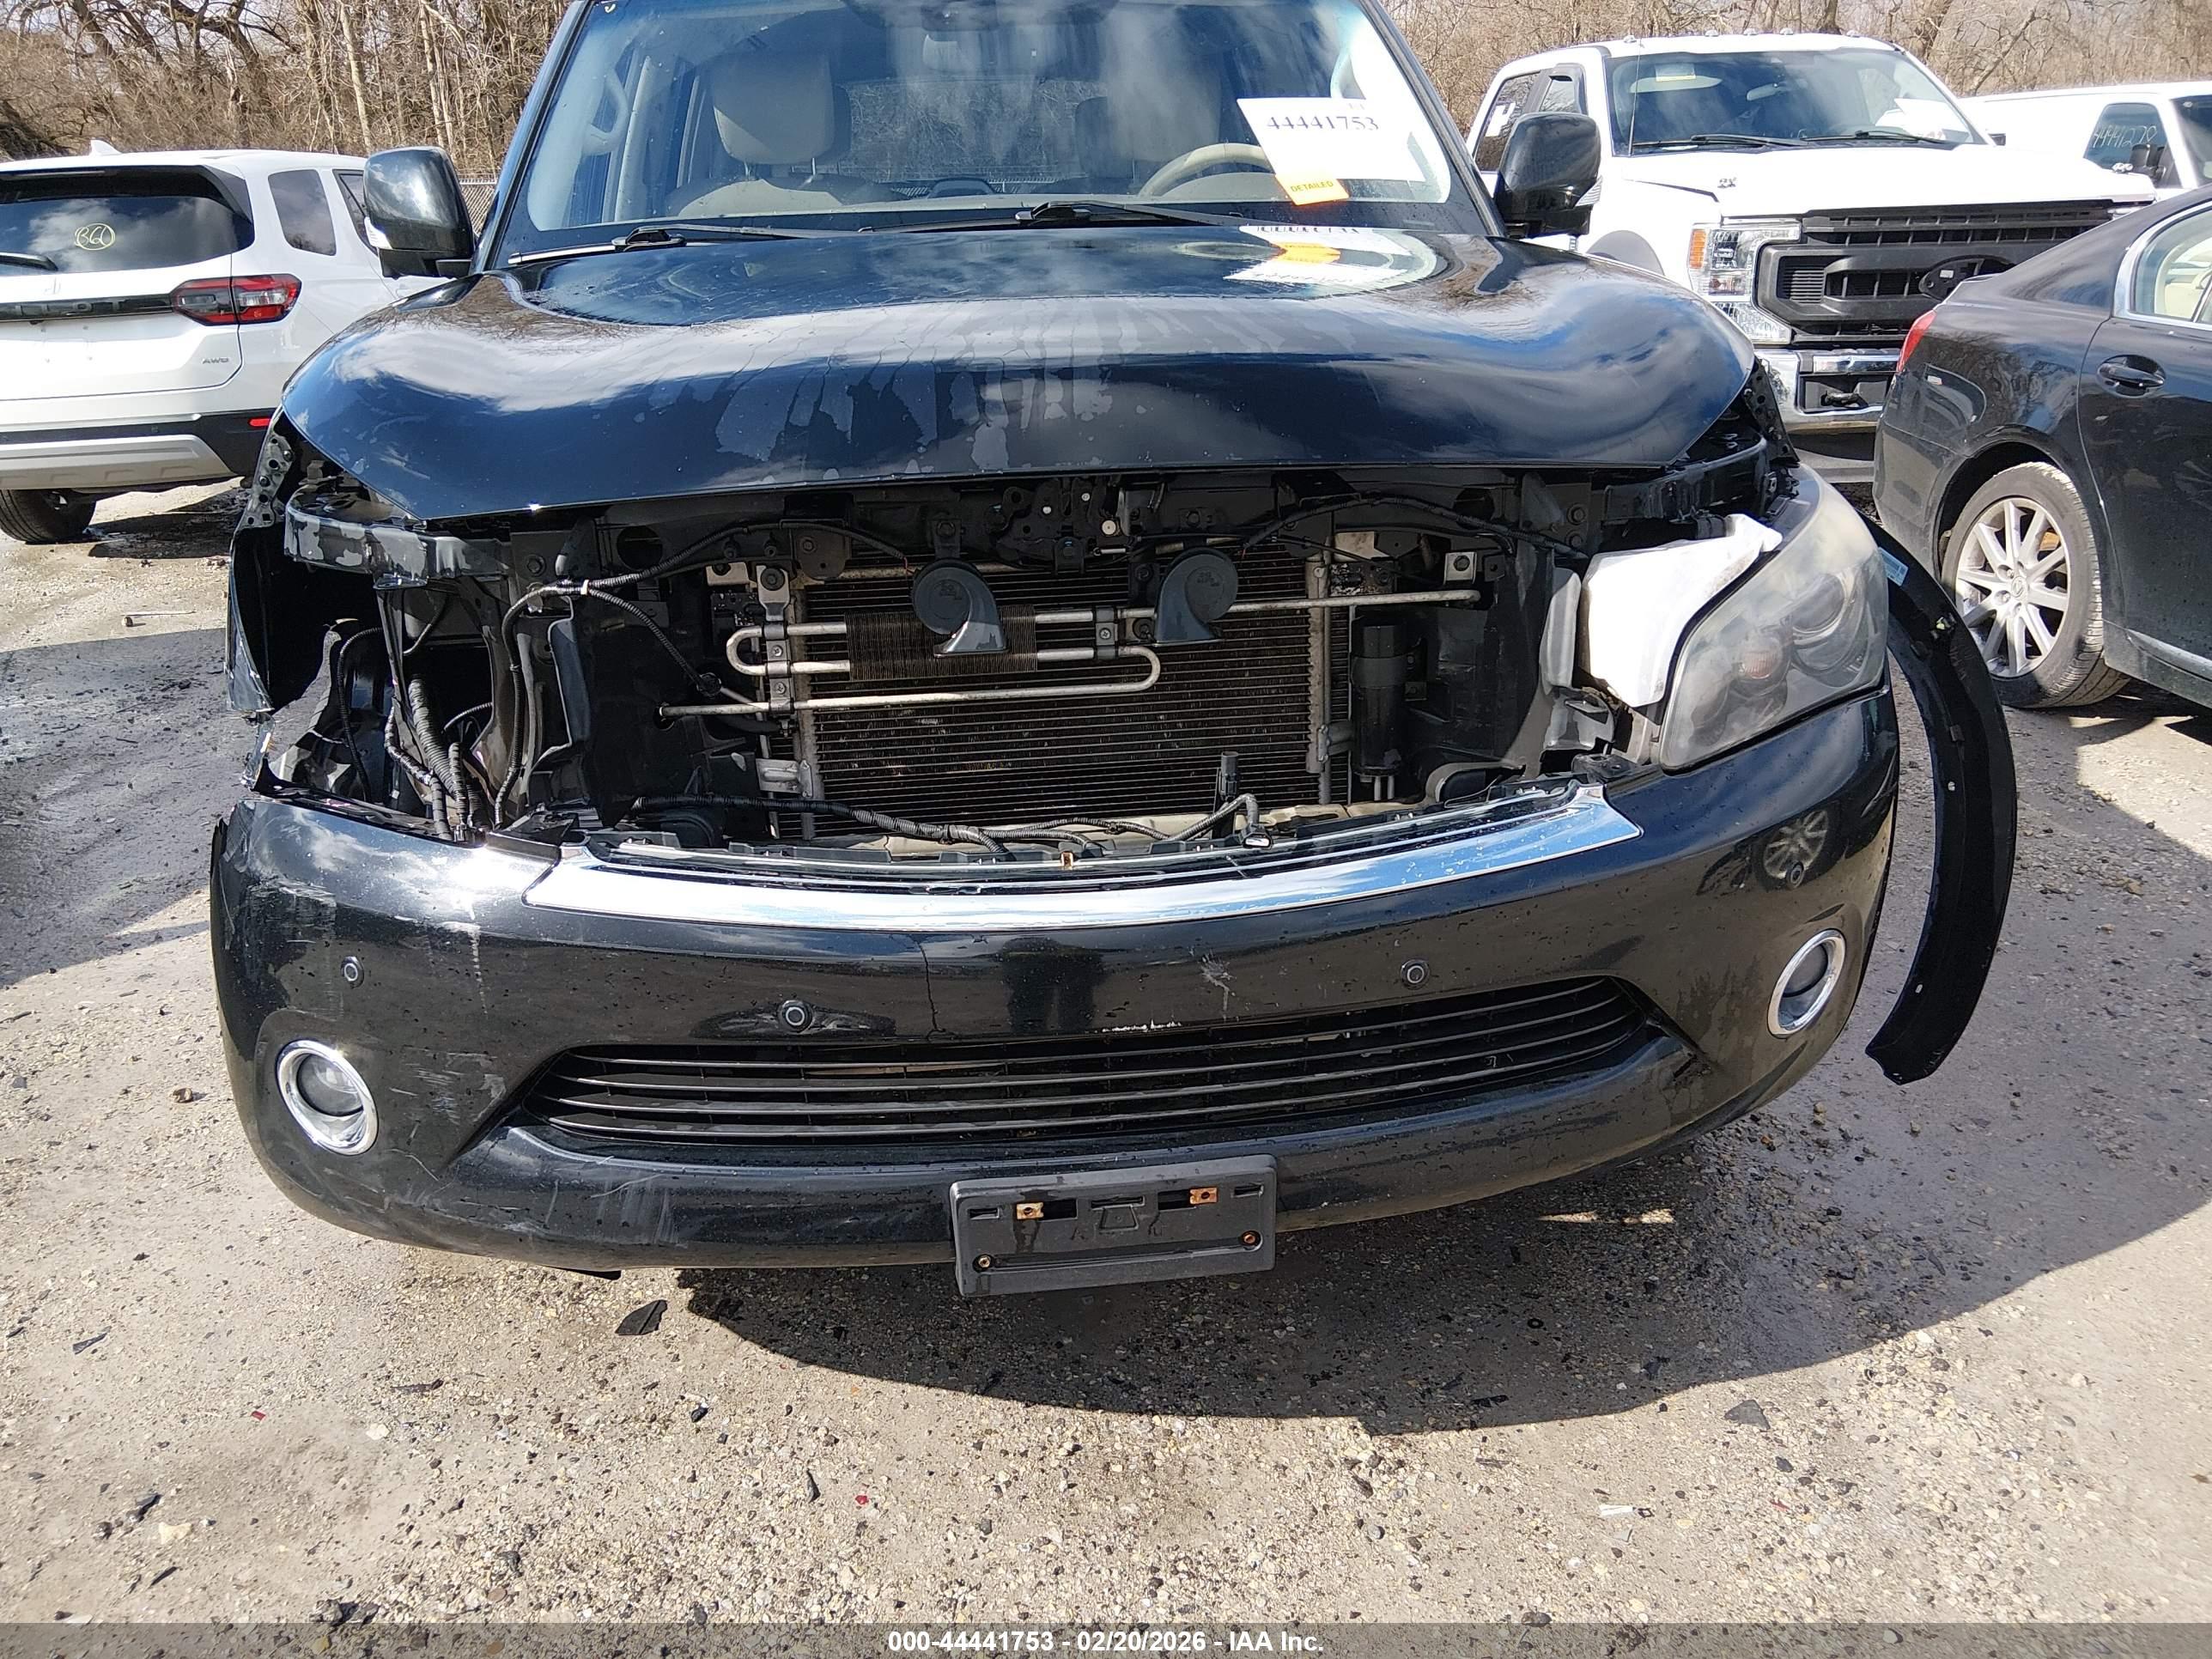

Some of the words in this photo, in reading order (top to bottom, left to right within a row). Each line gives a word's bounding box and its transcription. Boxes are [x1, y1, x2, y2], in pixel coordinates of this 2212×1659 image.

[1267, 116, 1379, 131] 44441753
[1290, 180, 1334, 192] DETAILED
[202, 356, 229, 365] AWD
